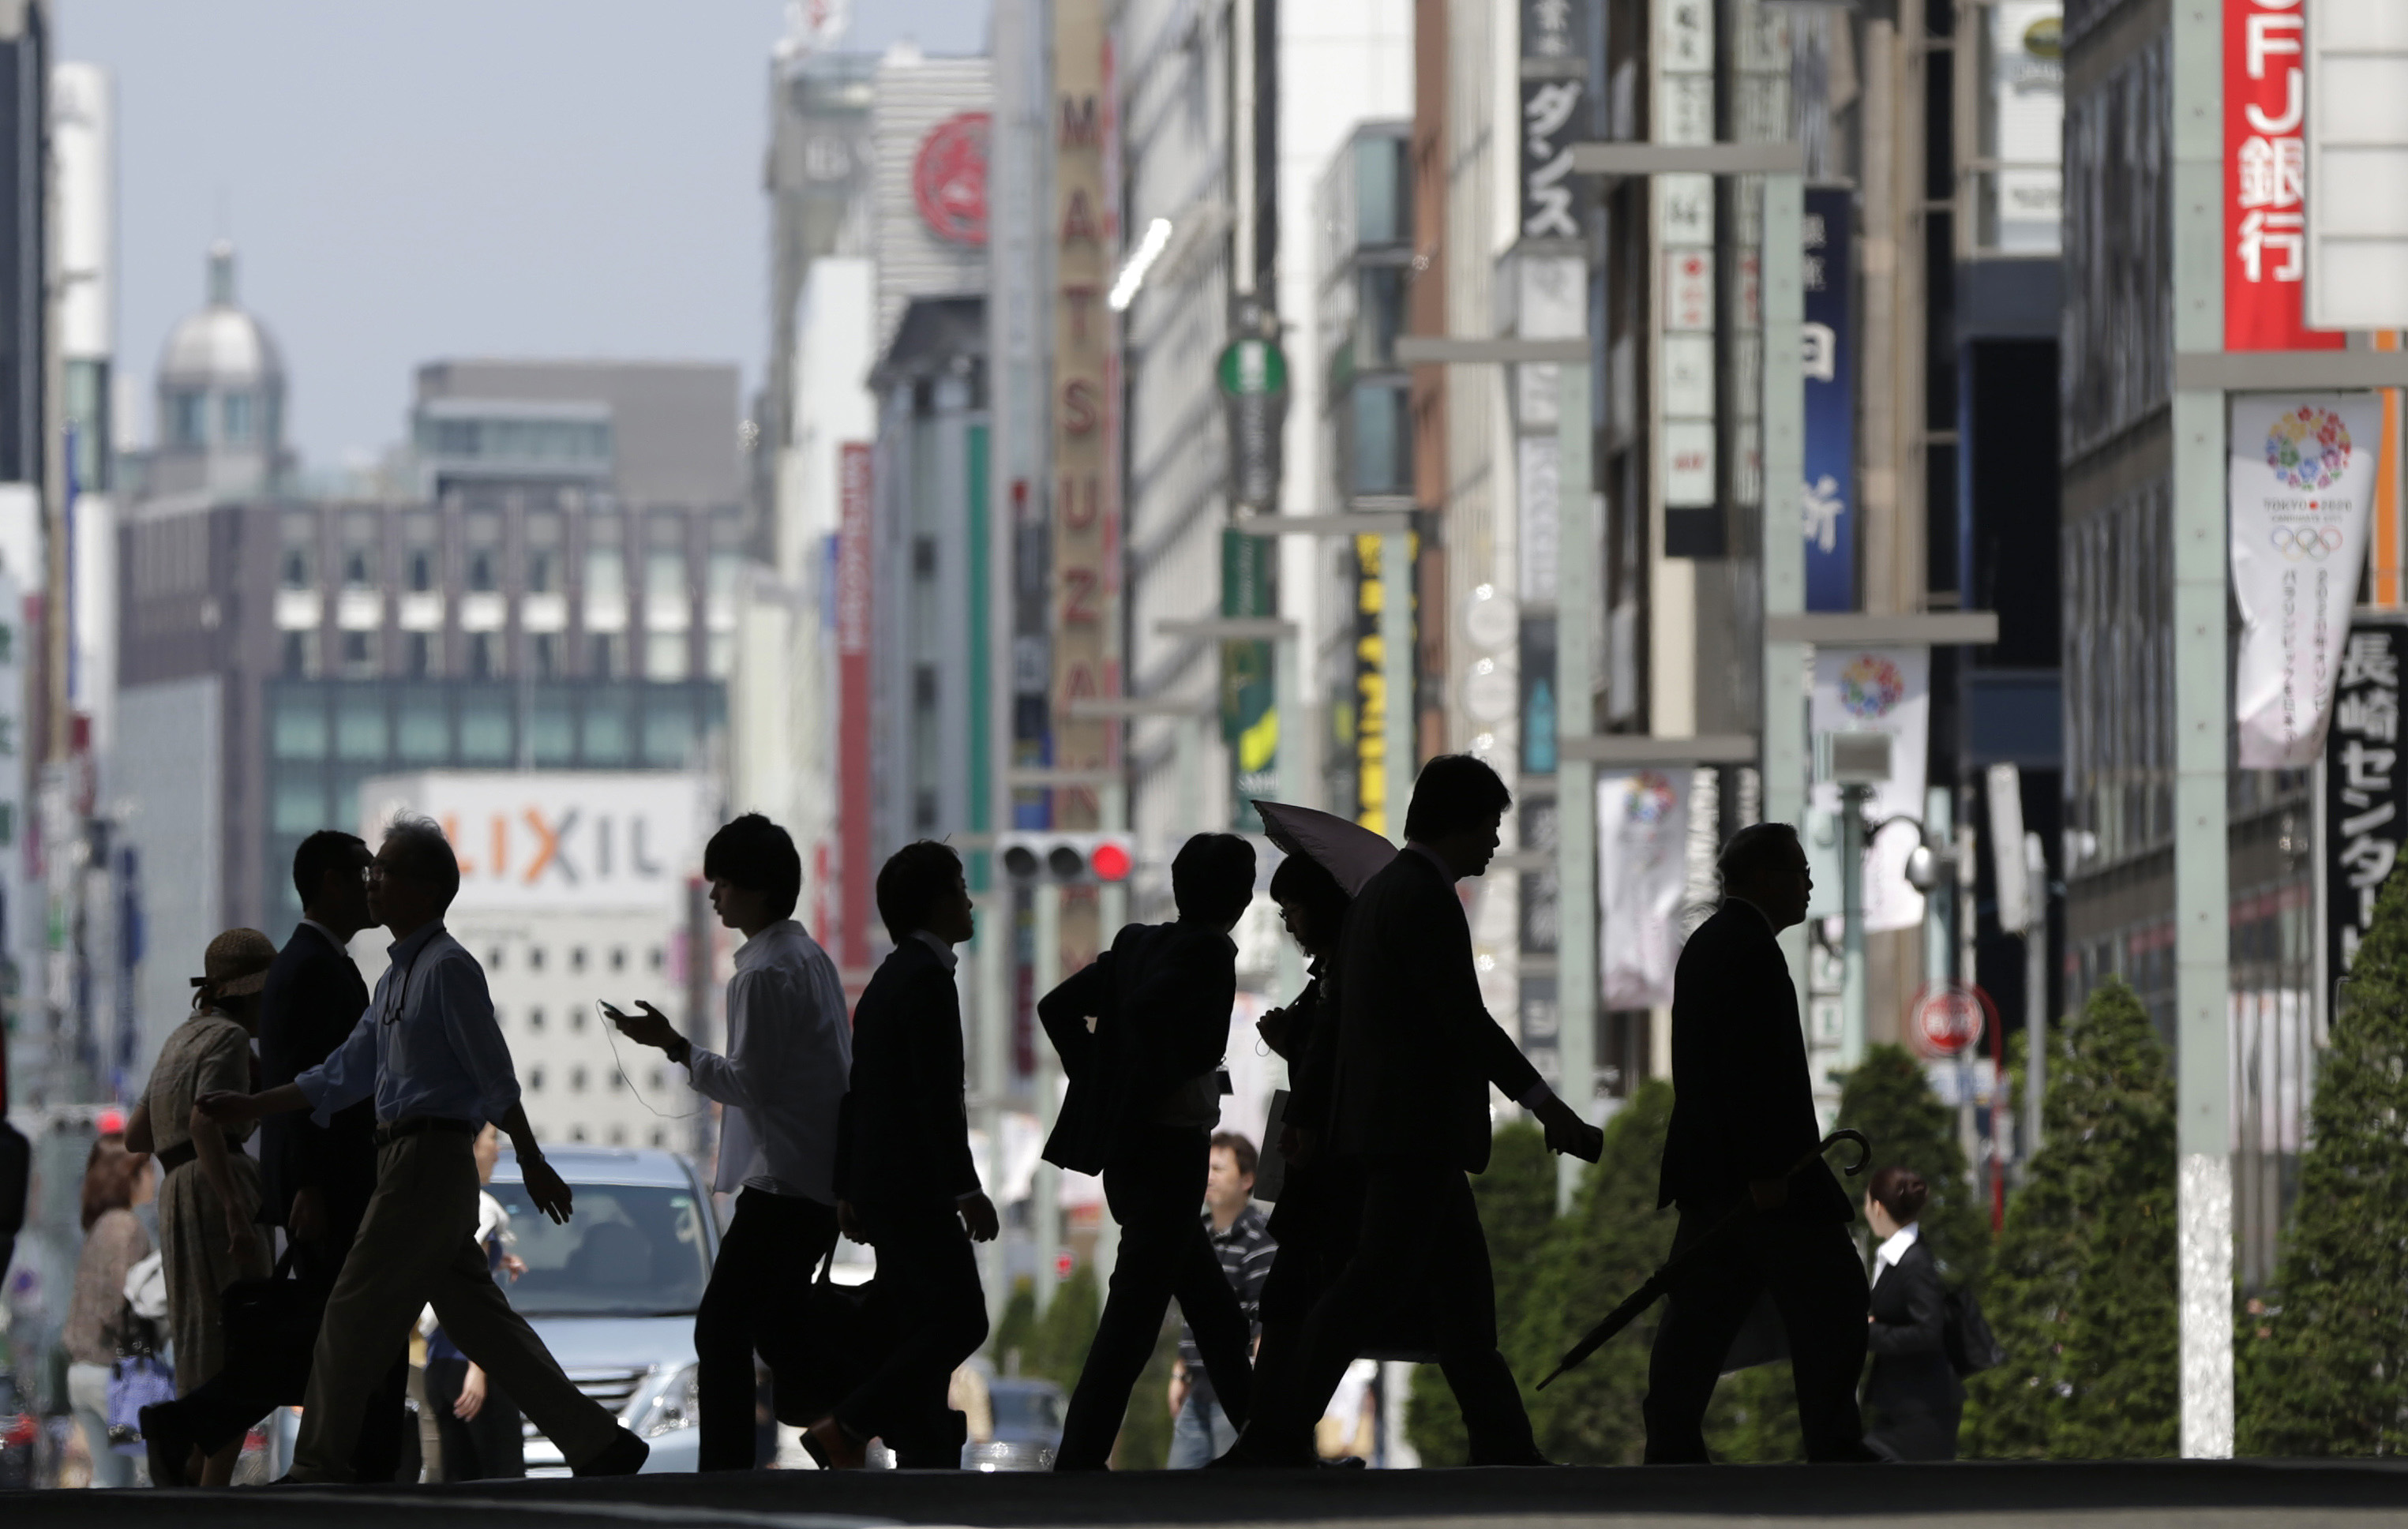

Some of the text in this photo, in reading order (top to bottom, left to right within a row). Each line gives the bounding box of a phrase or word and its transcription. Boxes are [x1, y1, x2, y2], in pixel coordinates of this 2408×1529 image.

[2237, 0, 2304, 283] FJ銀行
[2263, 497, 2307, 512] TOKYO
[443, 804, 663, 886] LIXIL
